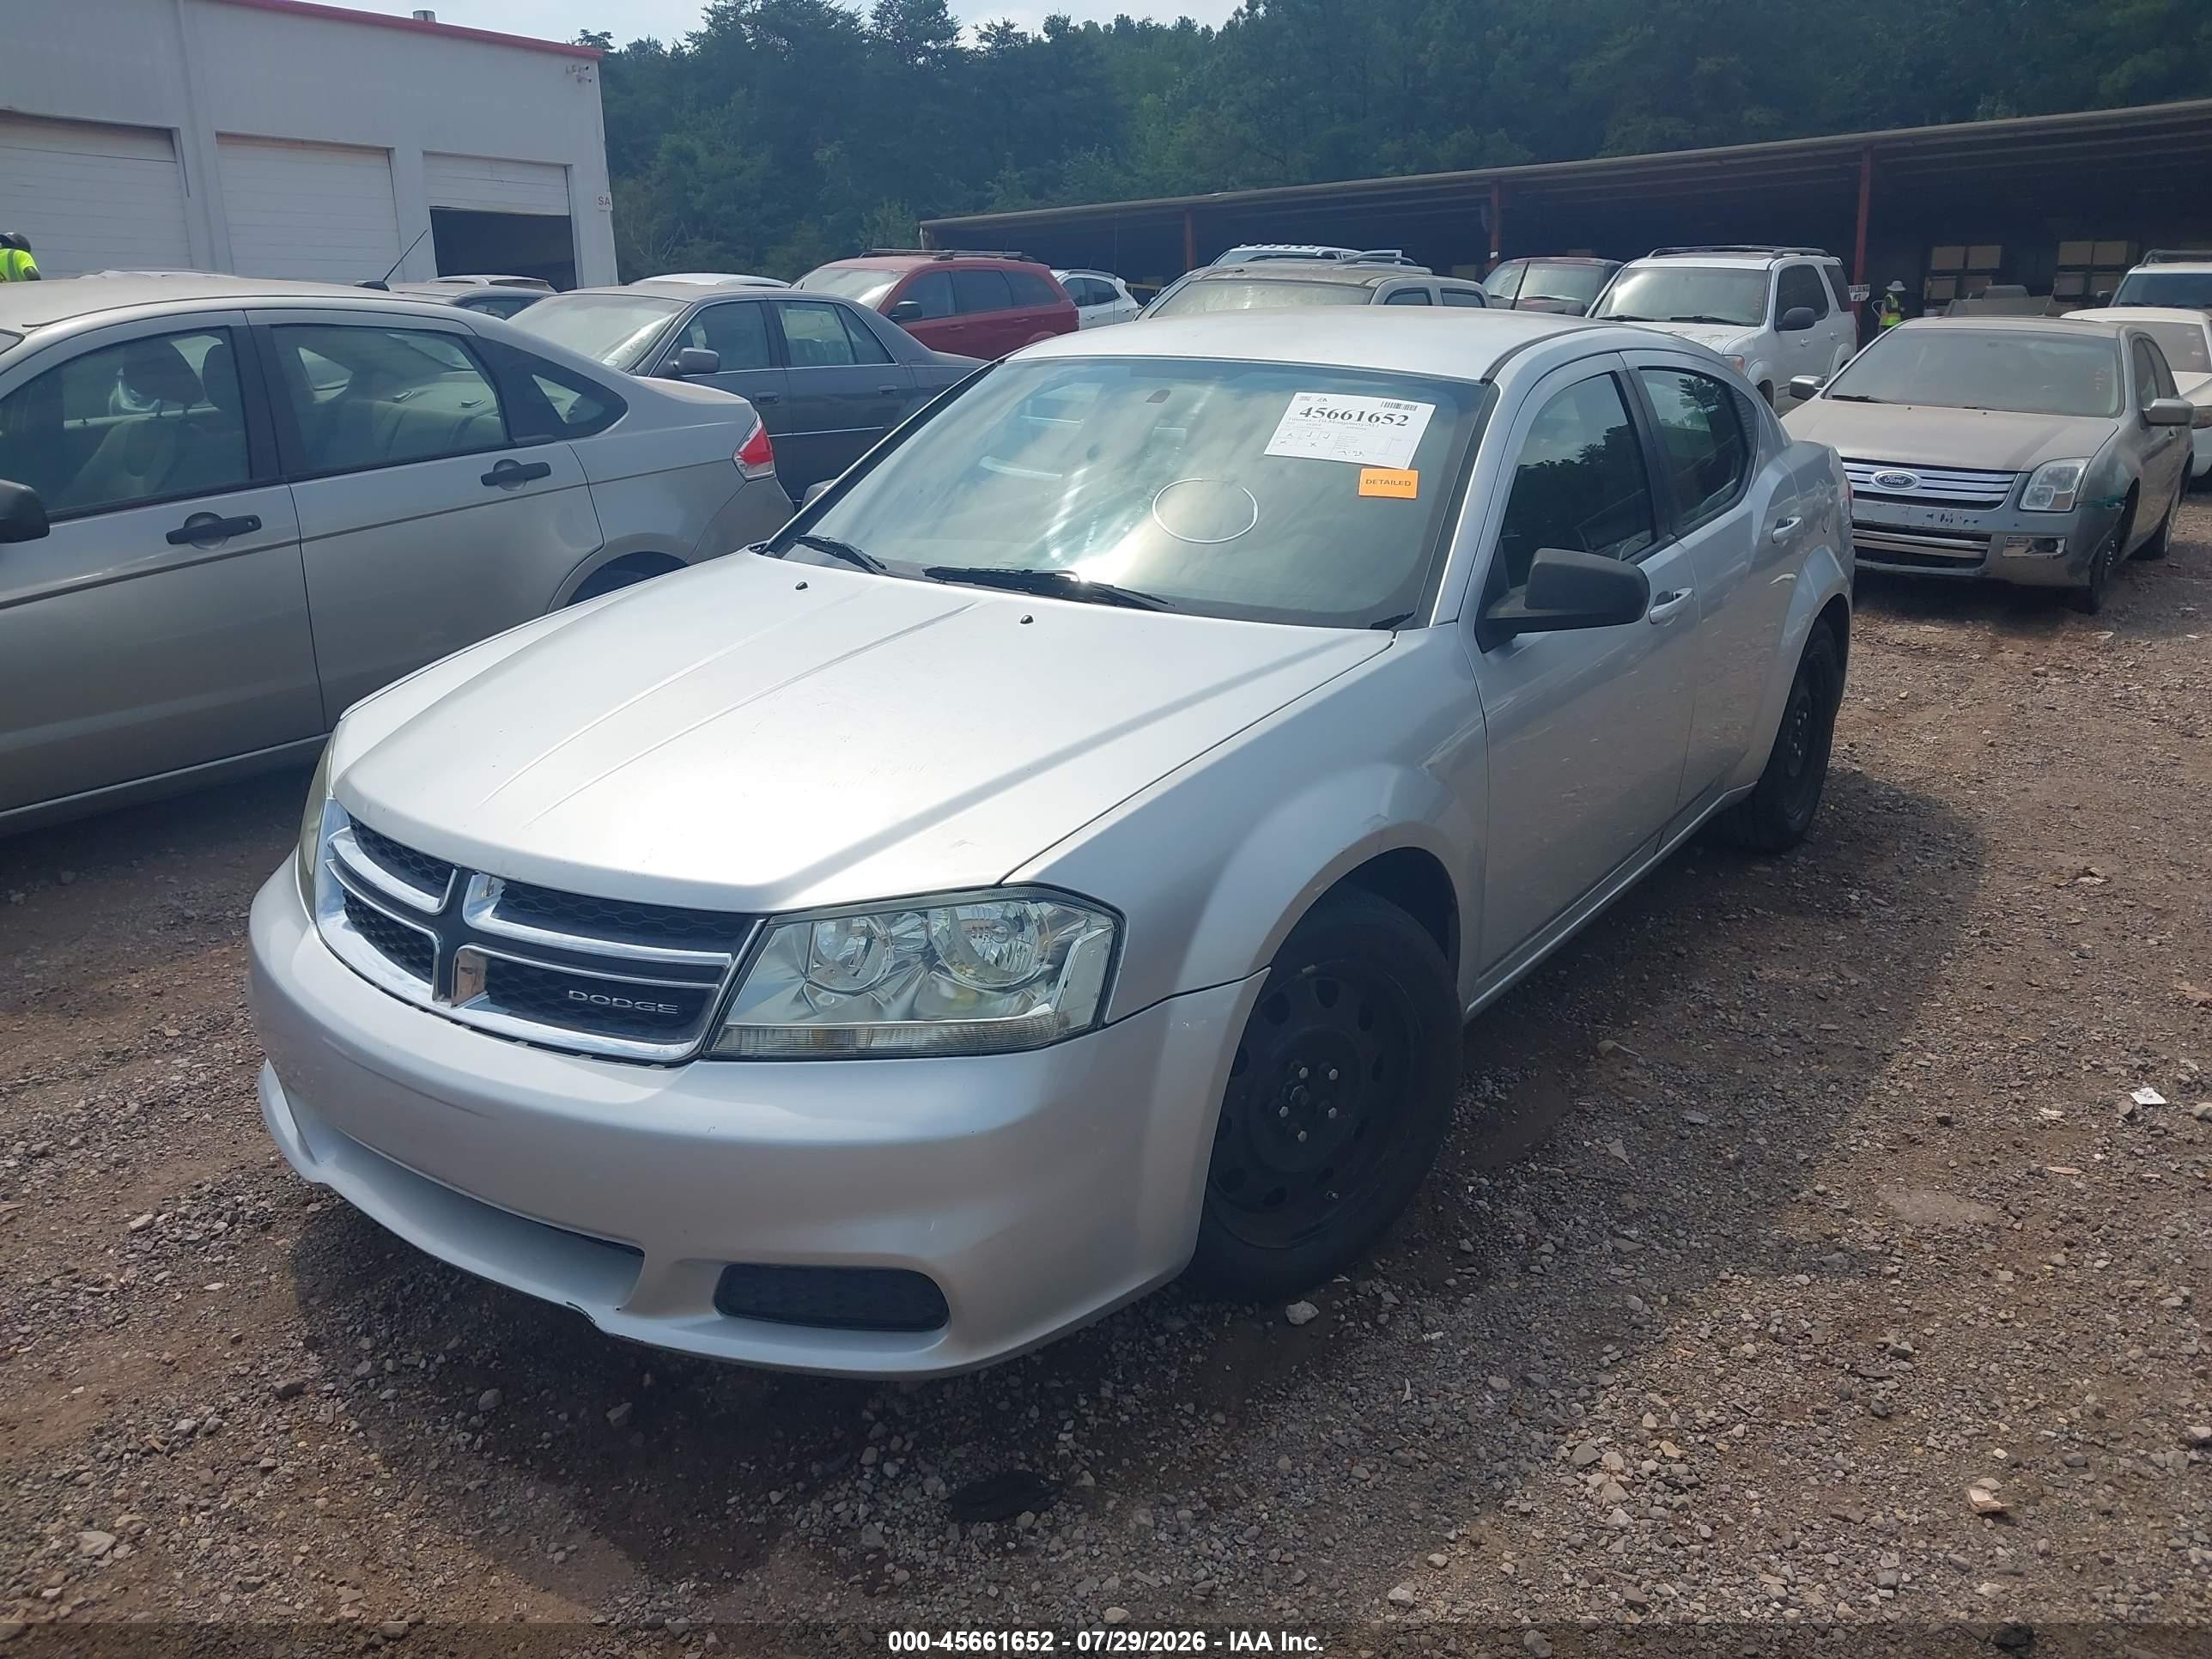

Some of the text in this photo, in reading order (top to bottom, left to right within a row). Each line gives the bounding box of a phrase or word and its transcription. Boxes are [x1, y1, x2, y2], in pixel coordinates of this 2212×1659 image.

[1299, 406, 1409, 427] 45661652
[1365, 478, 1412, 487] DETAILED
[1884, 475, 1906, 484] Ford
[568, 990, 678, 1014] DODGE
